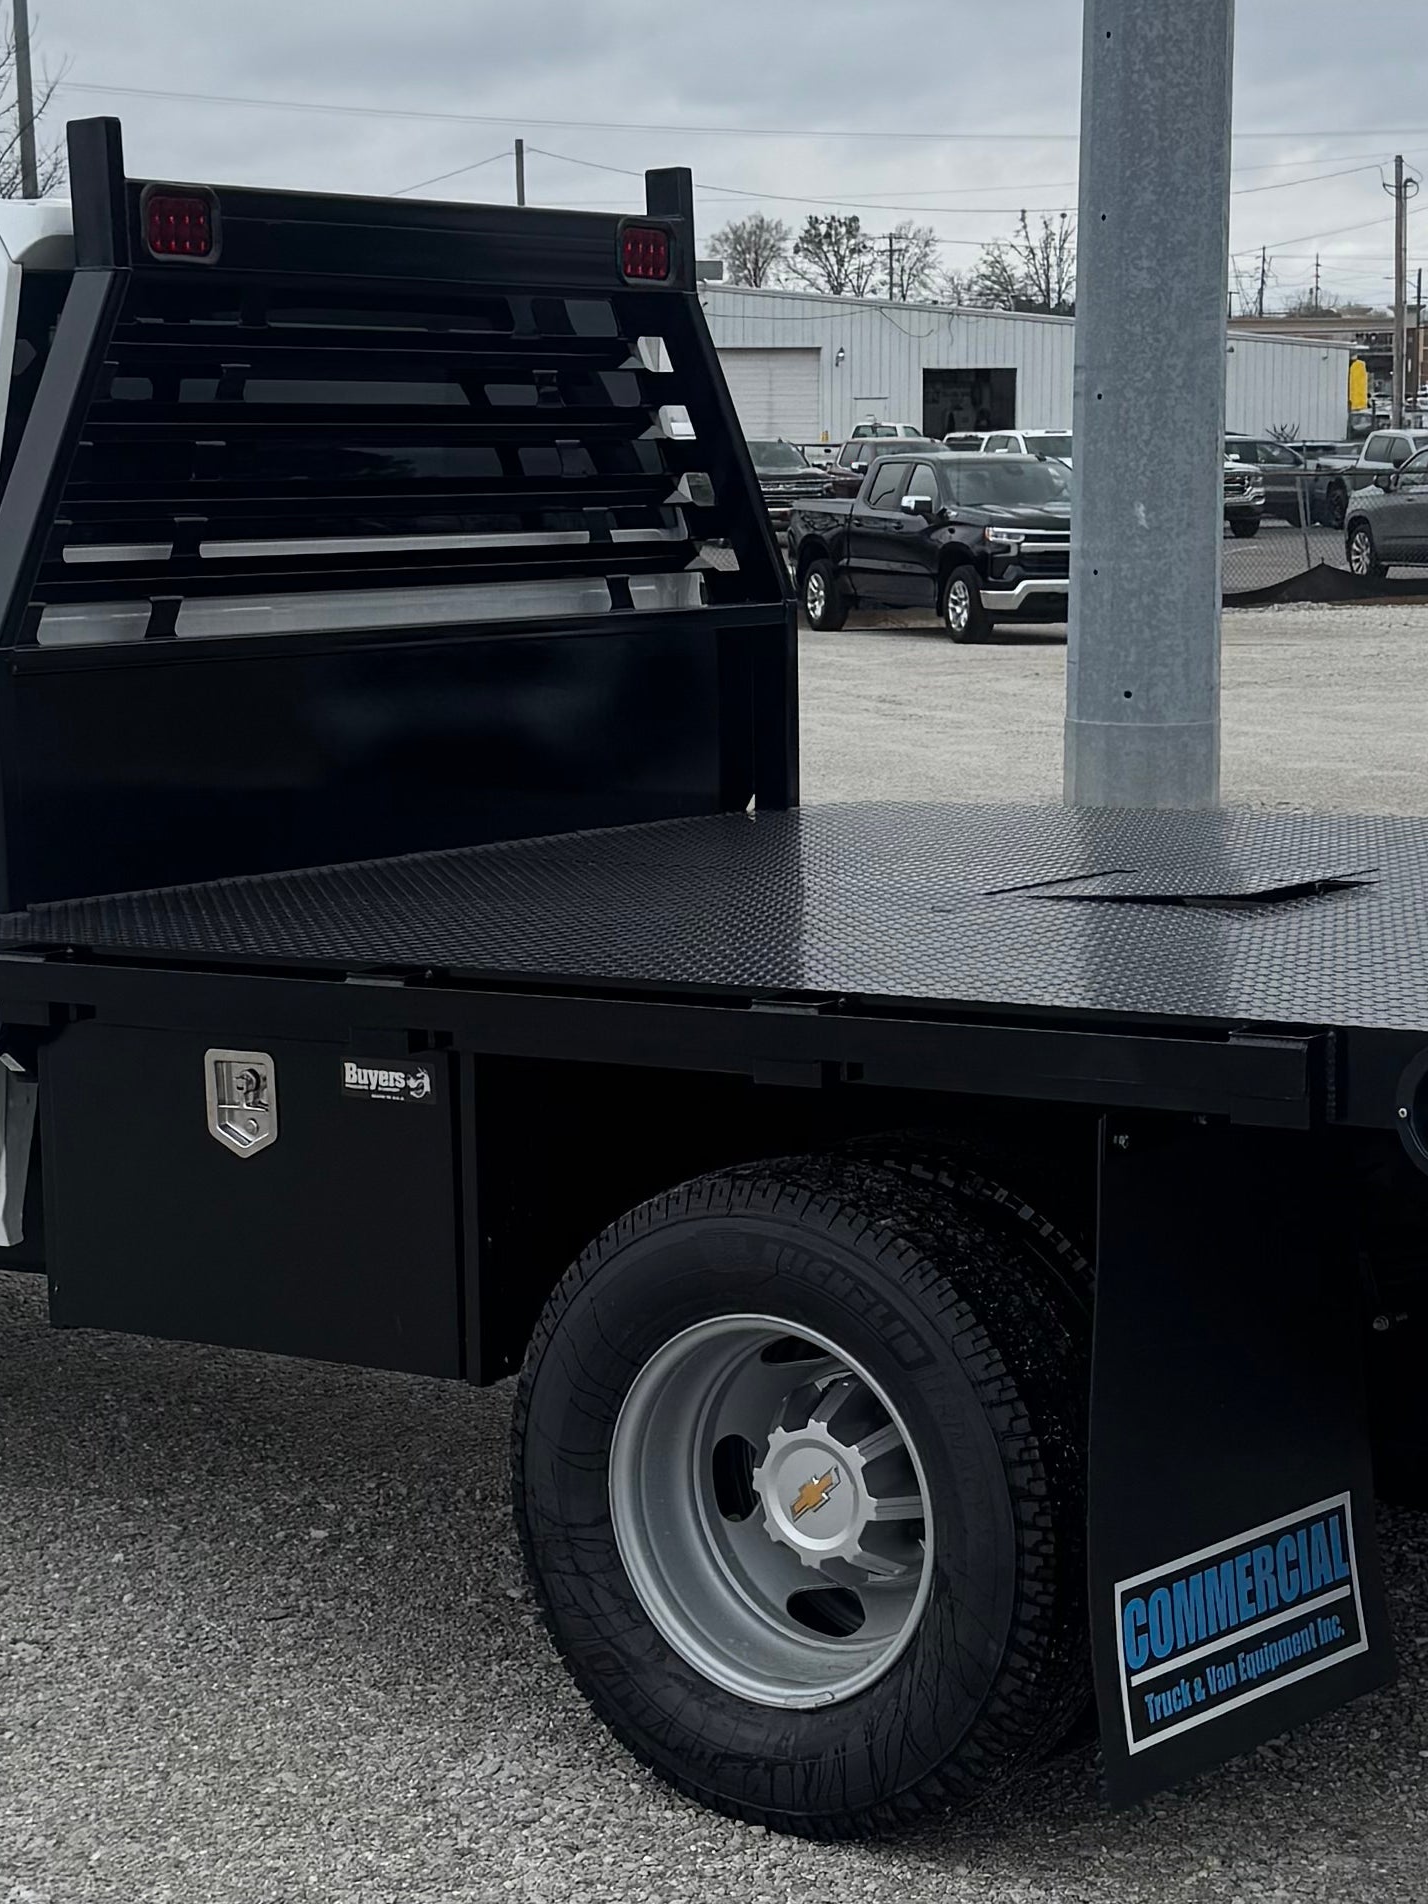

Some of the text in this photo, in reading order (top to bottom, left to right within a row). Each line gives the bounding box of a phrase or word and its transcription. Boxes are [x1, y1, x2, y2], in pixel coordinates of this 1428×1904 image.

[344, 1062, 405, 1090] Buyers
[1123, 1514, 1350, 1671] COMMERCIAL
[1145, 1614, 1346, 1724] Truck & Van Equipment Inc.
